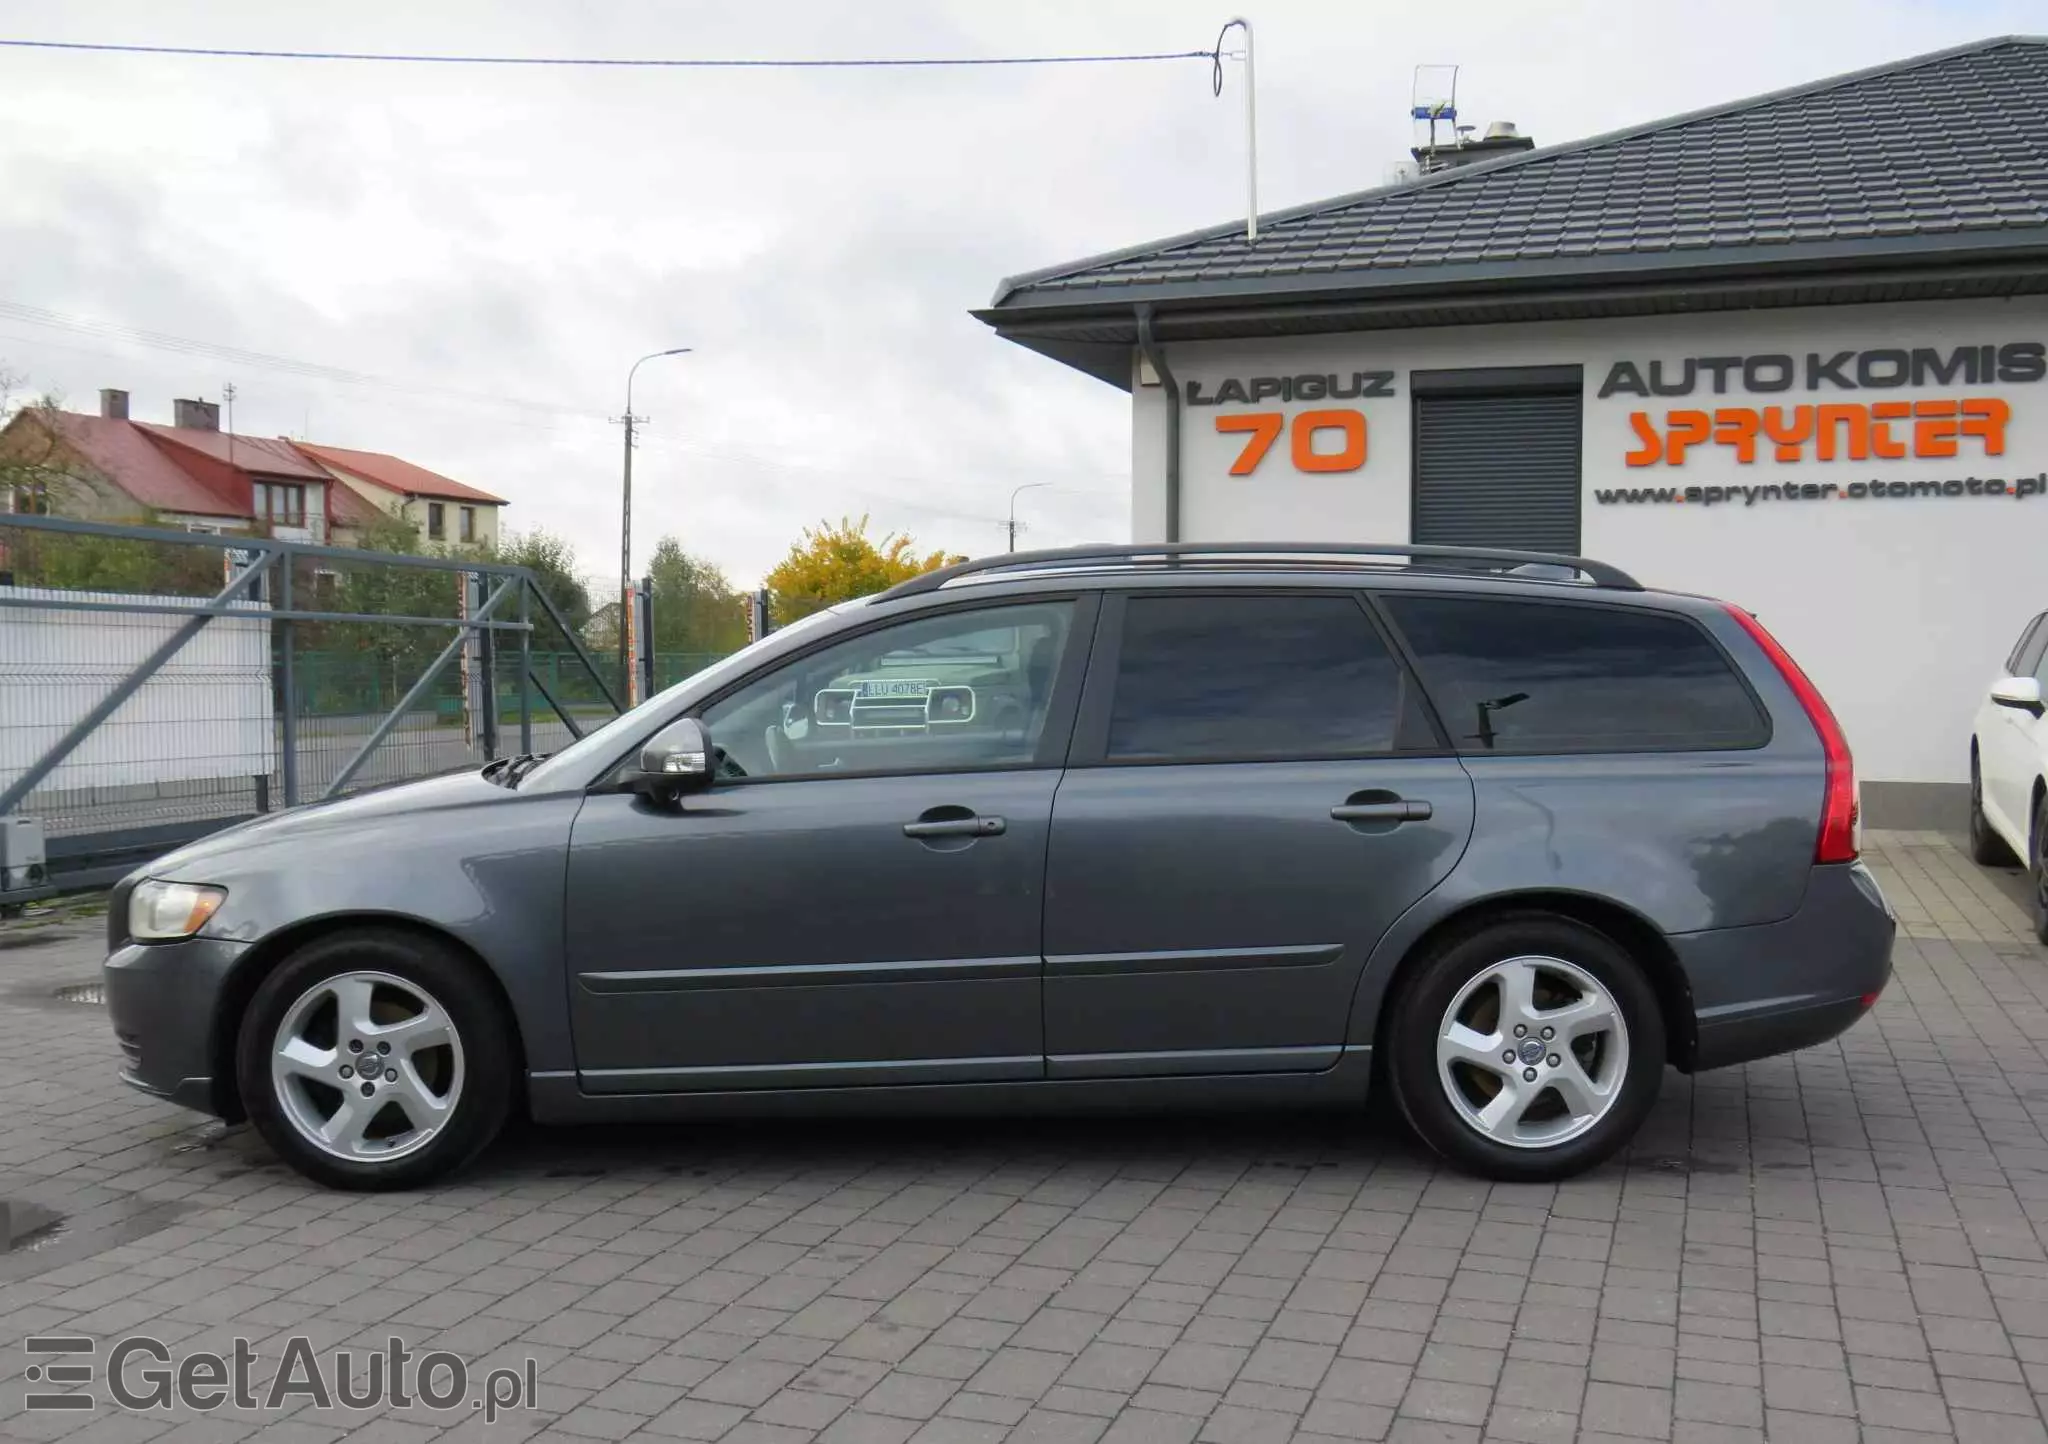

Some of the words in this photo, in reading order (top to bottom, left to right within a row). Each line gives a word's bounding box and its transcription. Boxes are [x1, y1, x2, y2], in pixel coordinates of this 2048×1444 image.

[1597, 354, 1794, 399] AUTO
[1806, 342, 2047, 391] KOMIS
[1215, 408, 1368, 477] 70
[1625, 398, 2012, 468] SPRYNTER
[1594, 473, 2047, 507] www.sprynter.otomoto.pl
